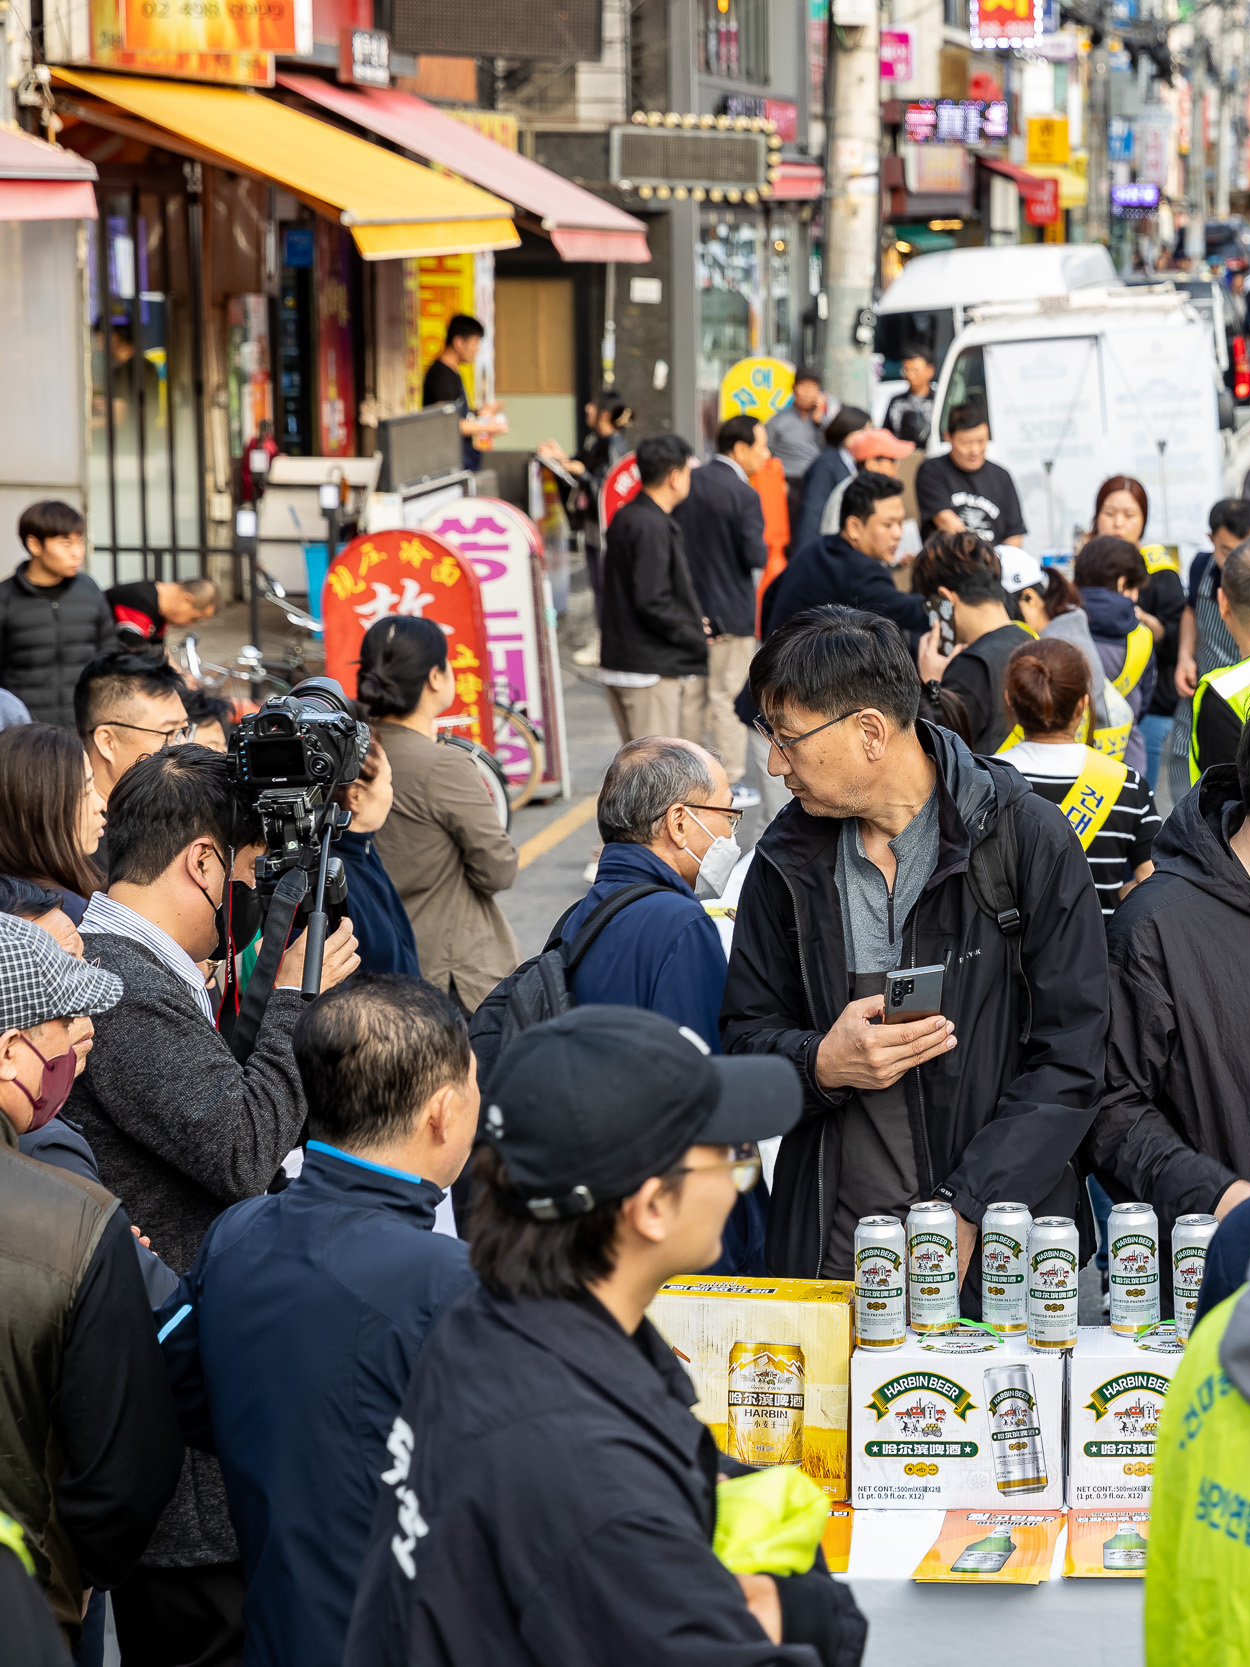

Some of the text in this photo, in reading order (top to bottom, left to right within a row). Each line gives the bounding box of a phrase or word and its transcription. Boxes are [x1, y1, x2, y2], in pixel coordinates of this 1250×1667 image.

[1065, 784, 1105, 836] 건대
[911, 1234, 949, 1247] HARBIN BEER
[998, 1234, 1016, 1248] BEER
[1115, 1236, 1153, 1248] HARBIN BEER
[858, 1248, 896, 1261] HARBIN BEER
[1036, 1250, 1074, 1263] HARBIN BEER
[1176, 1248, 1198, 1261] HARBIN
[884, 1375, 960, 1400] HARBIN BEER
[1102, 1375, 1171, 1399] HARBIN BEE
[728, 1391, 804, 1408] 哈尔滨啤酒
[993, 1390, 1029, 1405] HARBIN BEER
[744, 1408, 788, 1420] HARBIN
[753, 1420, 778, 1430] 小麦王
[882, 1444, 962, 1456] 哈尔滨啤酒
[865, 1493, 875, 1501] pt.
[877, 1493, 888, 1501] 0.9
[908, 1493, 925, 1501] X12)
[1085, 1493, 1096, 1501] pt.
[1096, 1493, 1107, 1501] 0.9
[1127, 1493, 1144, 1501] X12)
